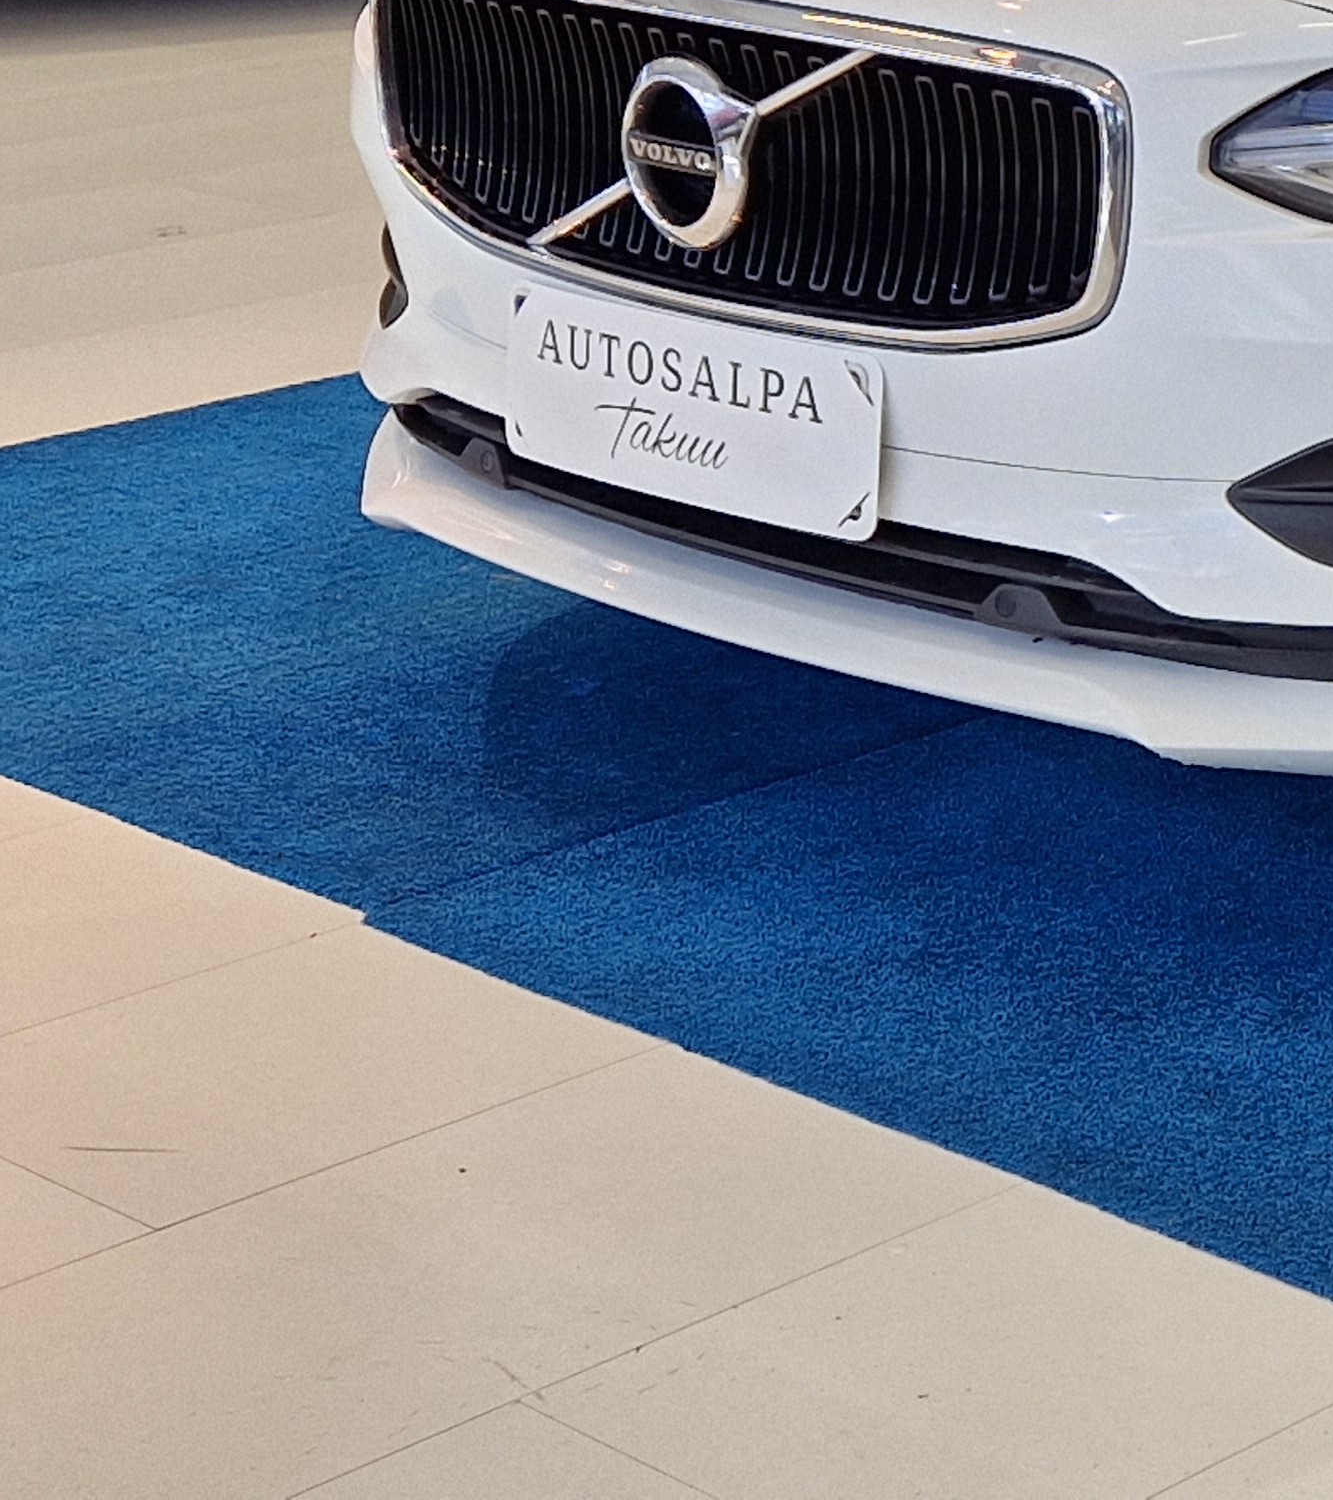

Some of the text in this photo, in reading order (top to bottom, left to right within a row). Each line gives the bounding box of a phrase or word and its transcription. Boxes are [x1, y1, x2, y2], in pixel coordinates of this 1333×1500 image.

[629, 138, 712, 171] VOLVO
[537, 319, 823, 424] AUTOSALPA
[594, 397, 729, 470] Takuu
